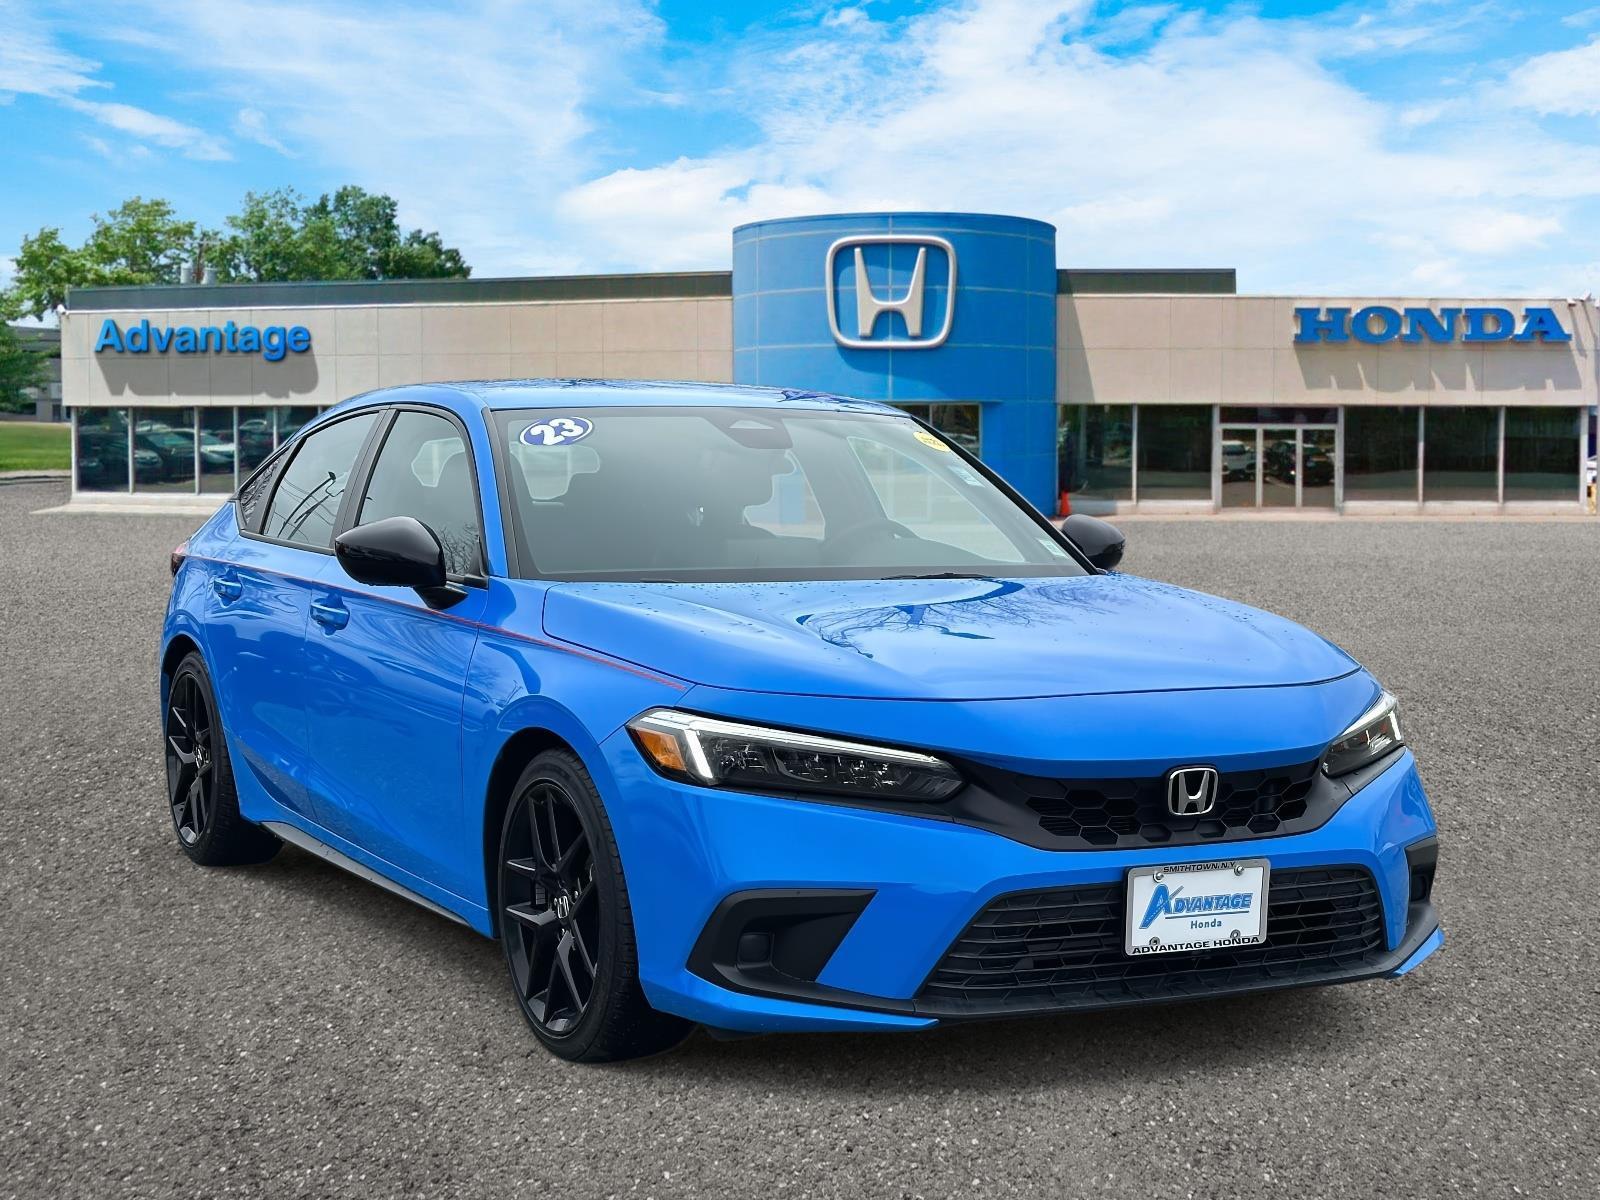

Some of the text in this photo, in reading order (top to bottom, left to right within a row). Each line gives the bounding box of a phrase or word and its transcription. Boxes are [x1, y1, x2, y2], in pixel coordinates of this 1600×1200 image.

[94, 319, 311, 362] Advantage
[1294, 306, 1572, 344] HONDA
[530, 418, 584, 446] 23
[1139, 884, 1253, 929] ADVANTAGE
[1190, 918, 1222, 929] Honda
[1132, 936, 1260, 954] ADVANTAGE HONDA
